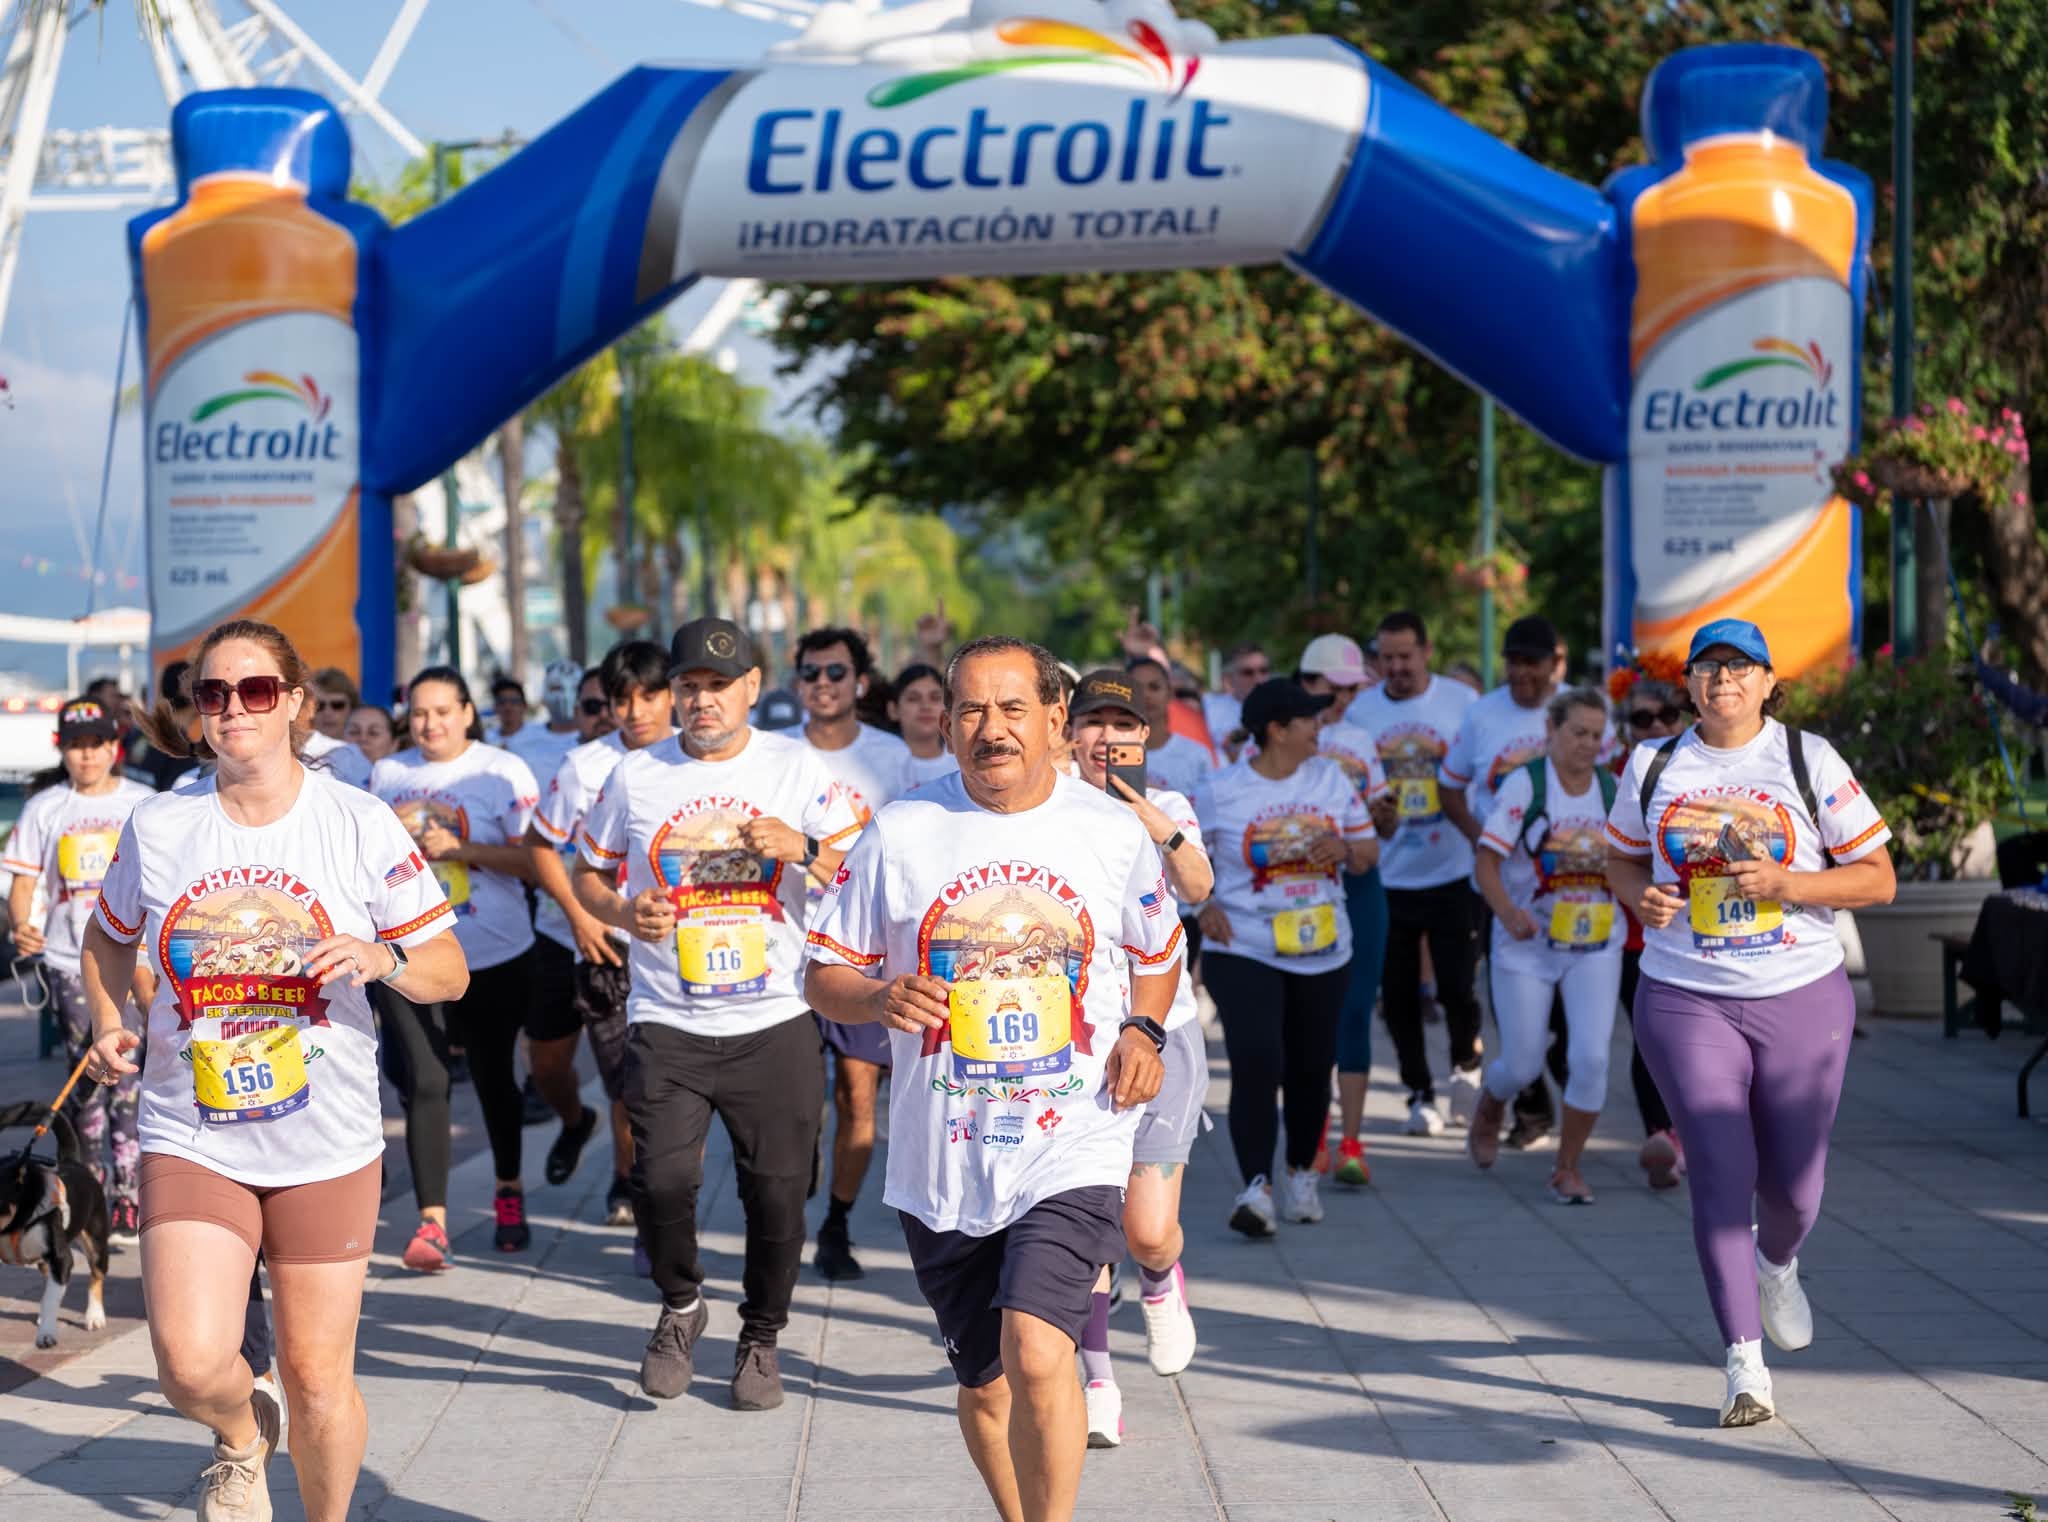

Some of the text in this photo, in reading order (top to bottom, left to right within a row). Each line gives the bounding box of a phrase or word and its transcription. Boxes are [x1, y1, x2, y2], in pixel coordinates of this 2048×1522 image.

[745, 97, 1233, 196] Electrolit
[738, 206, 1055, 251] ¡HIDRATACIÓN
[1069, 205, 1221, 238] TOTAL!
[1643, 387, 1839, 432] Electrolit
[155, 419, 341, 463] Electrolit
[666, 793, 768, 827] CHAPAL
[184, 864, 320, 912] CHAPALA
[678, 889, 722, 909] TACOS
[939, 859, 1087, 920] CHAPALA
[1717, 900, 1756, 925] 149
[706, 949, 742, 972] 116
[191, 983, 306, 1005] TACOS & BEER
[228, 1006, 295, 1019] FESTIVAL
[987, 1012, 1039, 1045] 169
[222, 1062, 274, 1096] 156
[982, 1133, 1024, 1146] Chapal
